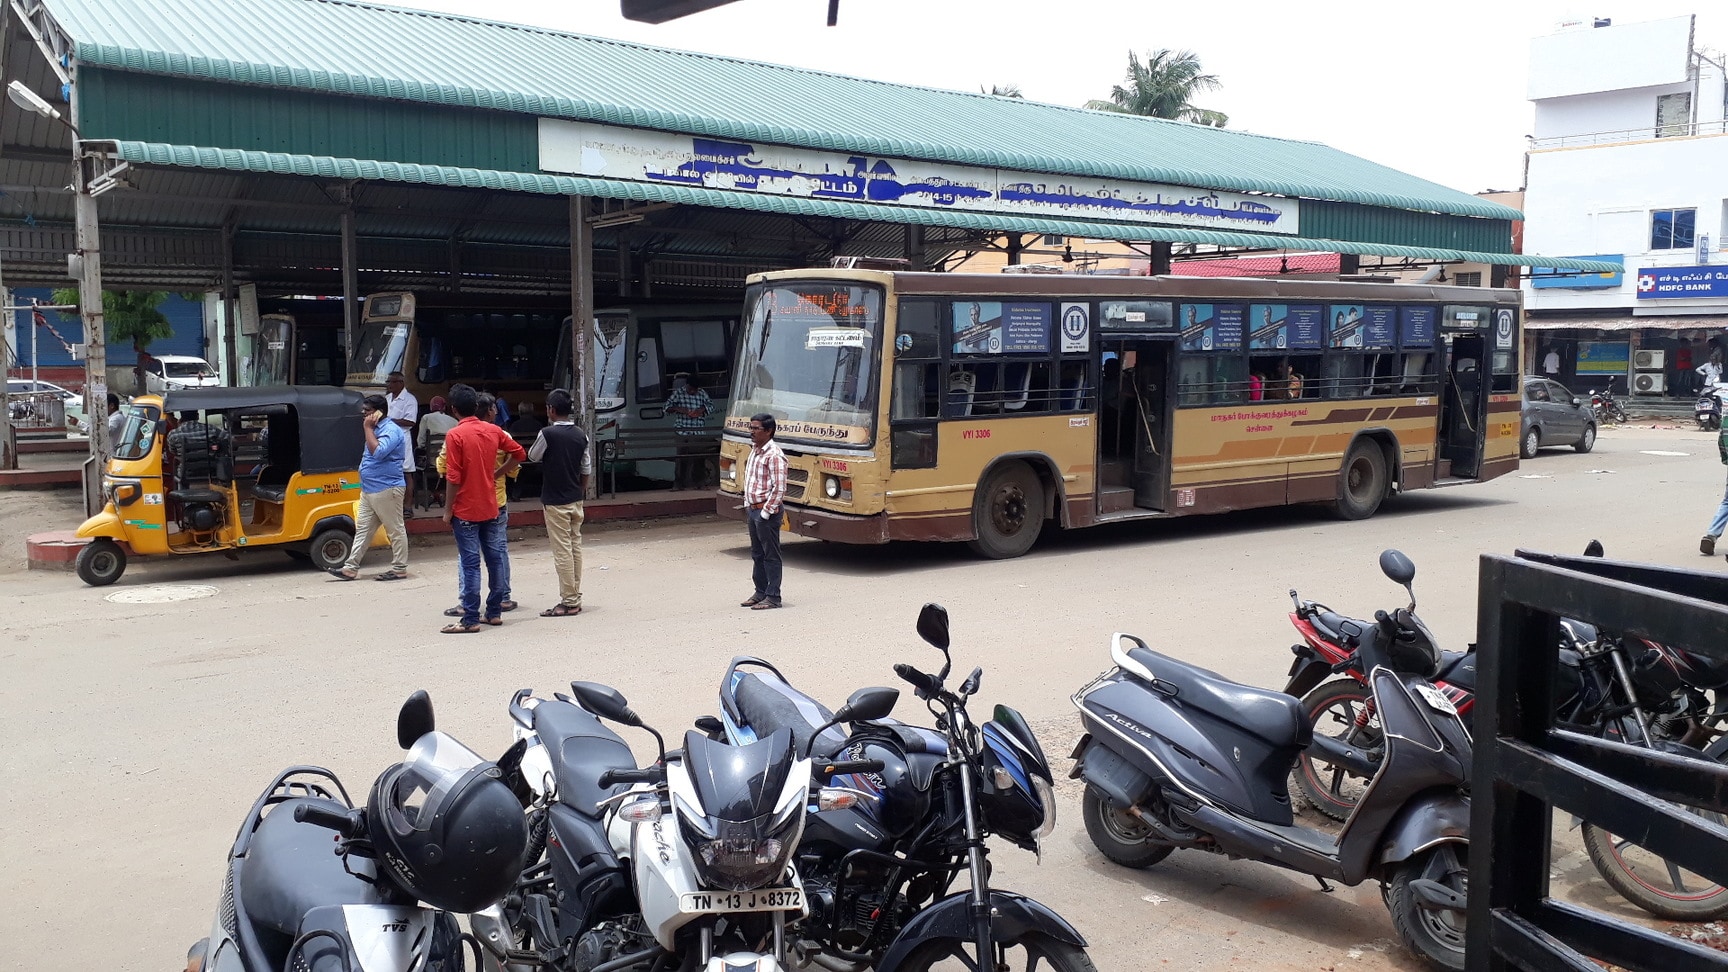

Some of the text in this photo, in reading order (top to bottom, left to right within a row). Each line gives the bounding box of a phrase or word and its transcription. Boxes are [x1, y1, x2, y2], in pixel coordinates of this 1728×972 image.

[1685, 283, 1711, 291] BANK
[975, 429, 991, 439] 3306
[1105, 713, 1151, 739] Activa
[693, 895, 711, 909] TN
[749, 894, 756, 908] J
[768, 891, 800, 906] 8372
[382, 924, 407, 932] TVS
